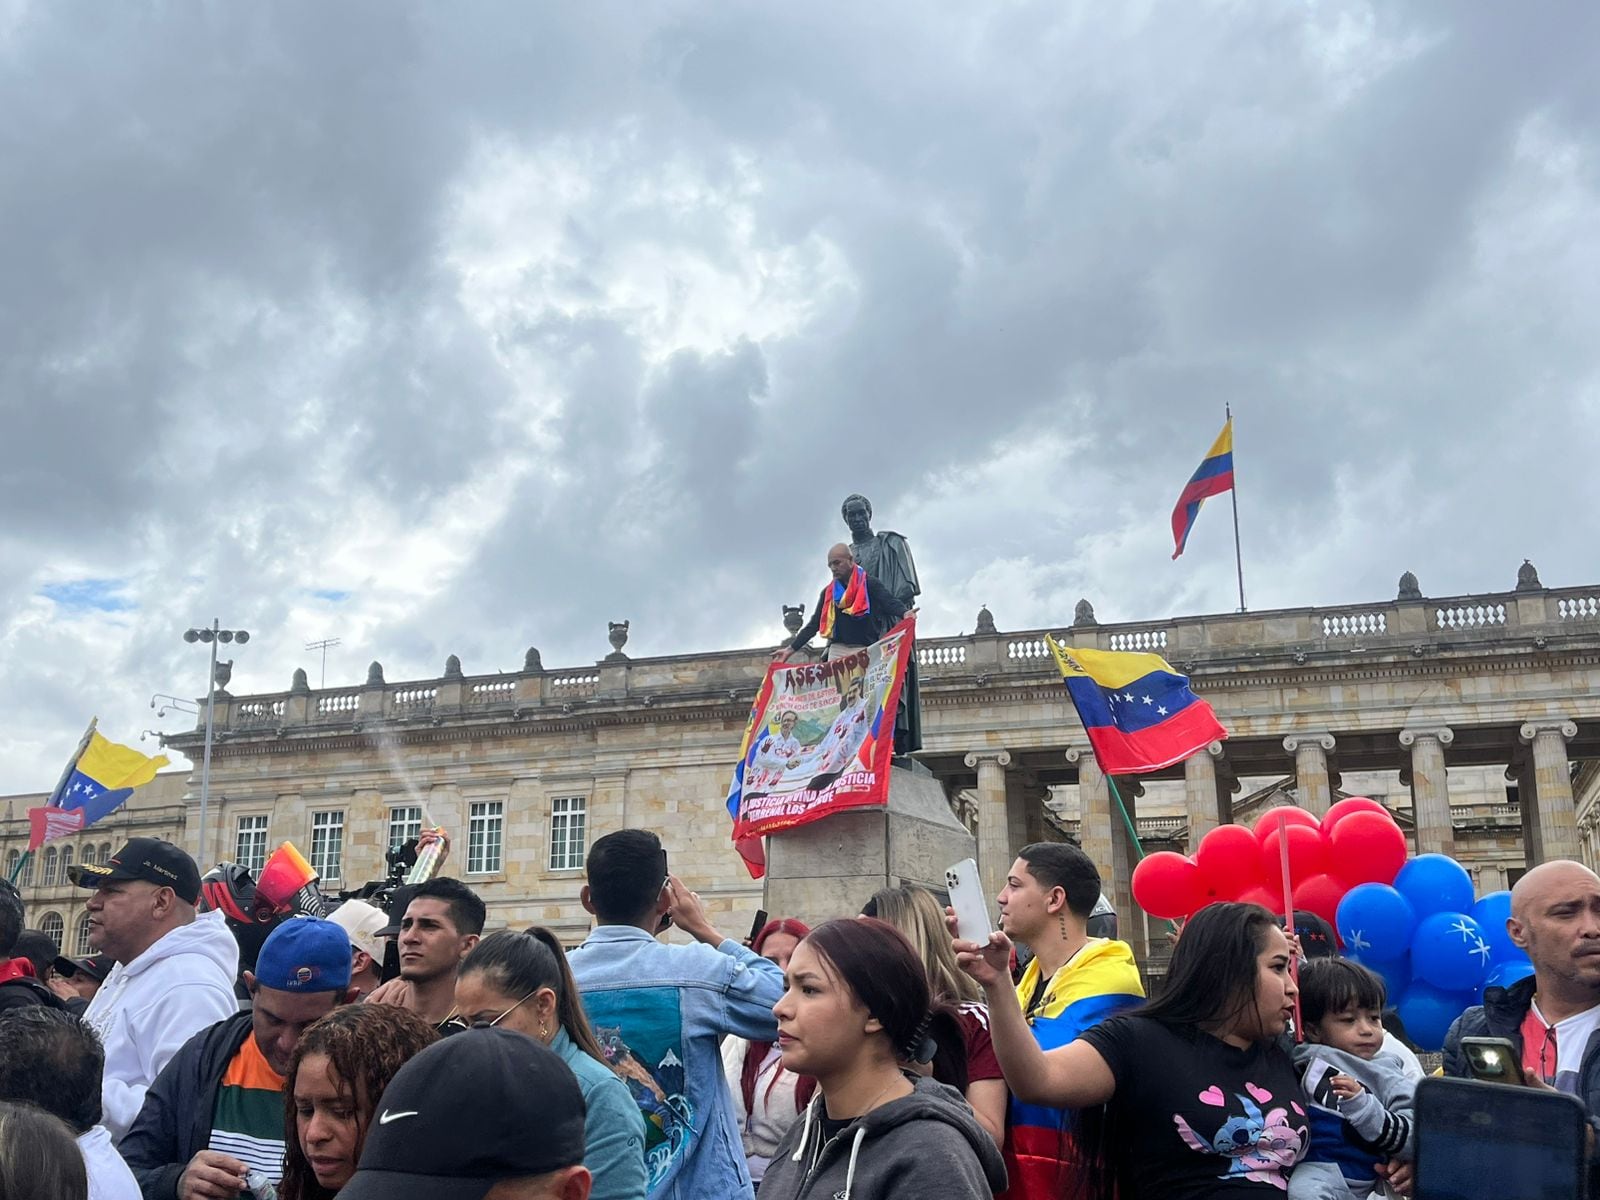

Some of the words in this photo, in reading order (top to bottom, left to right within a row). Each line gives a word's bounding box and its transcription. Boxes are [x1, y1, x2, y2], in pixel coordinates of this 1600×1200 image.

[784, 648, 870, 694] ASESINOS
[747, 796, 786, 810] JUSTICIA
[831, 772, 876, 791] JUSTICIA
[785, 802, 806, 816] LOS
